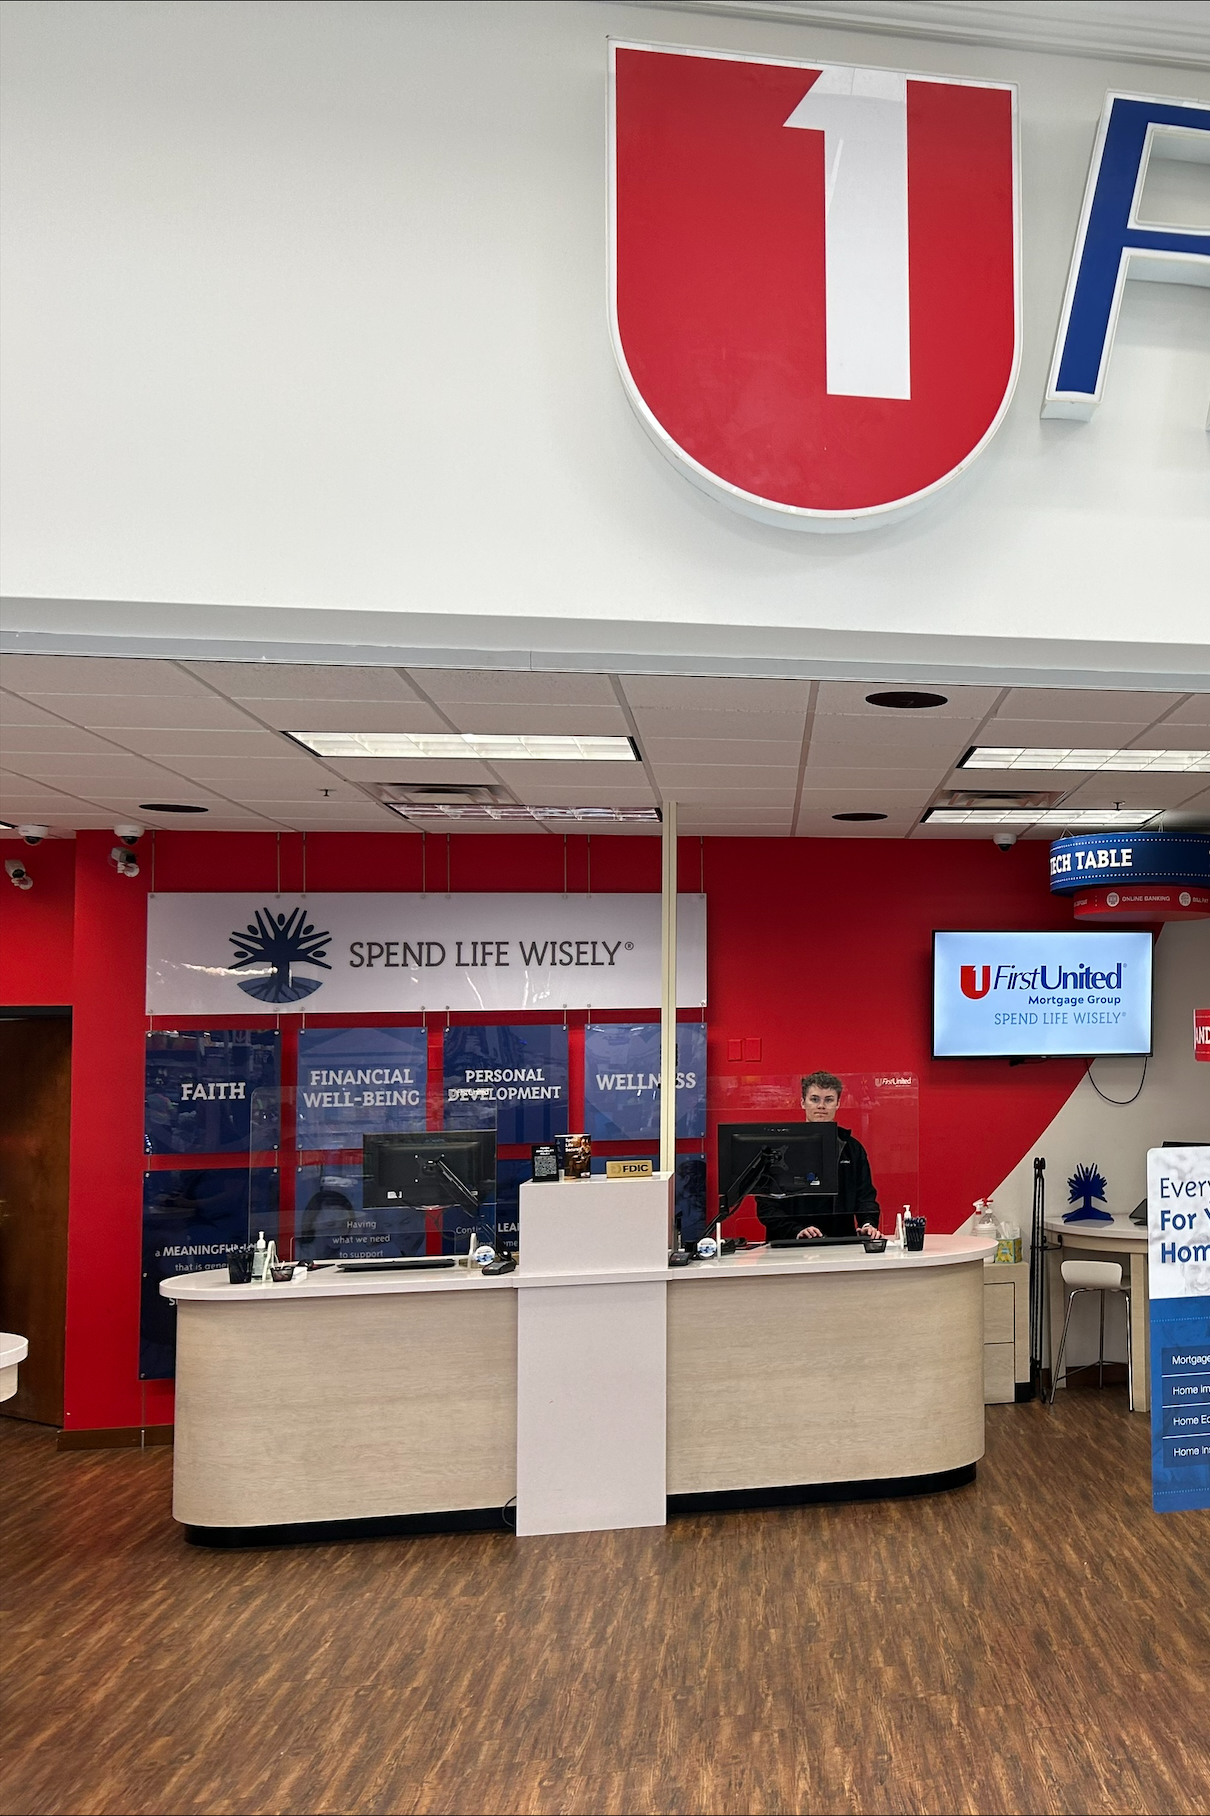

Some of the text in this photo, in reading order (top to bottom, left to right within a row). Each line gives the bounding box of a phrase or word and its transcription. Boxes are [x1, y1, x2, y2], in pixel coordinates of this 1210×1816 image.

[1050, 848, 1133, 875] TECH TABLE
[349, 941, 446, 968] SPEND
[455, 941, 509, 967] LIFE
[1028, 995, 1121, 1006] Mortgage Group
[994, 1013, 1038, 1025] SPEND
[1043, 1013, 1068, 1024] LIFE
[310, 1068, 414, 1086] FINANCIAL
[465, 1068, 545, 1083] PERSONAL
[596, 1072, 697, 1090] WELLNSS
[181, 1082, 246, 1100] FAITH
[448, 1086, 562, 1102] DEVELOPMENT
[303, 1090, 420, 1108] WELL-BEING
[623, 1164, 649, 1173] FDIC
[346, 1220, 377, 1230] Having
[1160, 1210, 1197, 1231] For
[332, 1235, 353, 1244] what
[370, 1234, 391, 1243] need
[350, 1250, 383, 1258] support
[175, 1262, 193, 1271] that
[1172, 1386, 1199, 1396] Home
[1173, 1416, 1199, 1426] Home
[1173, 1447, 1199, 1457] Home
